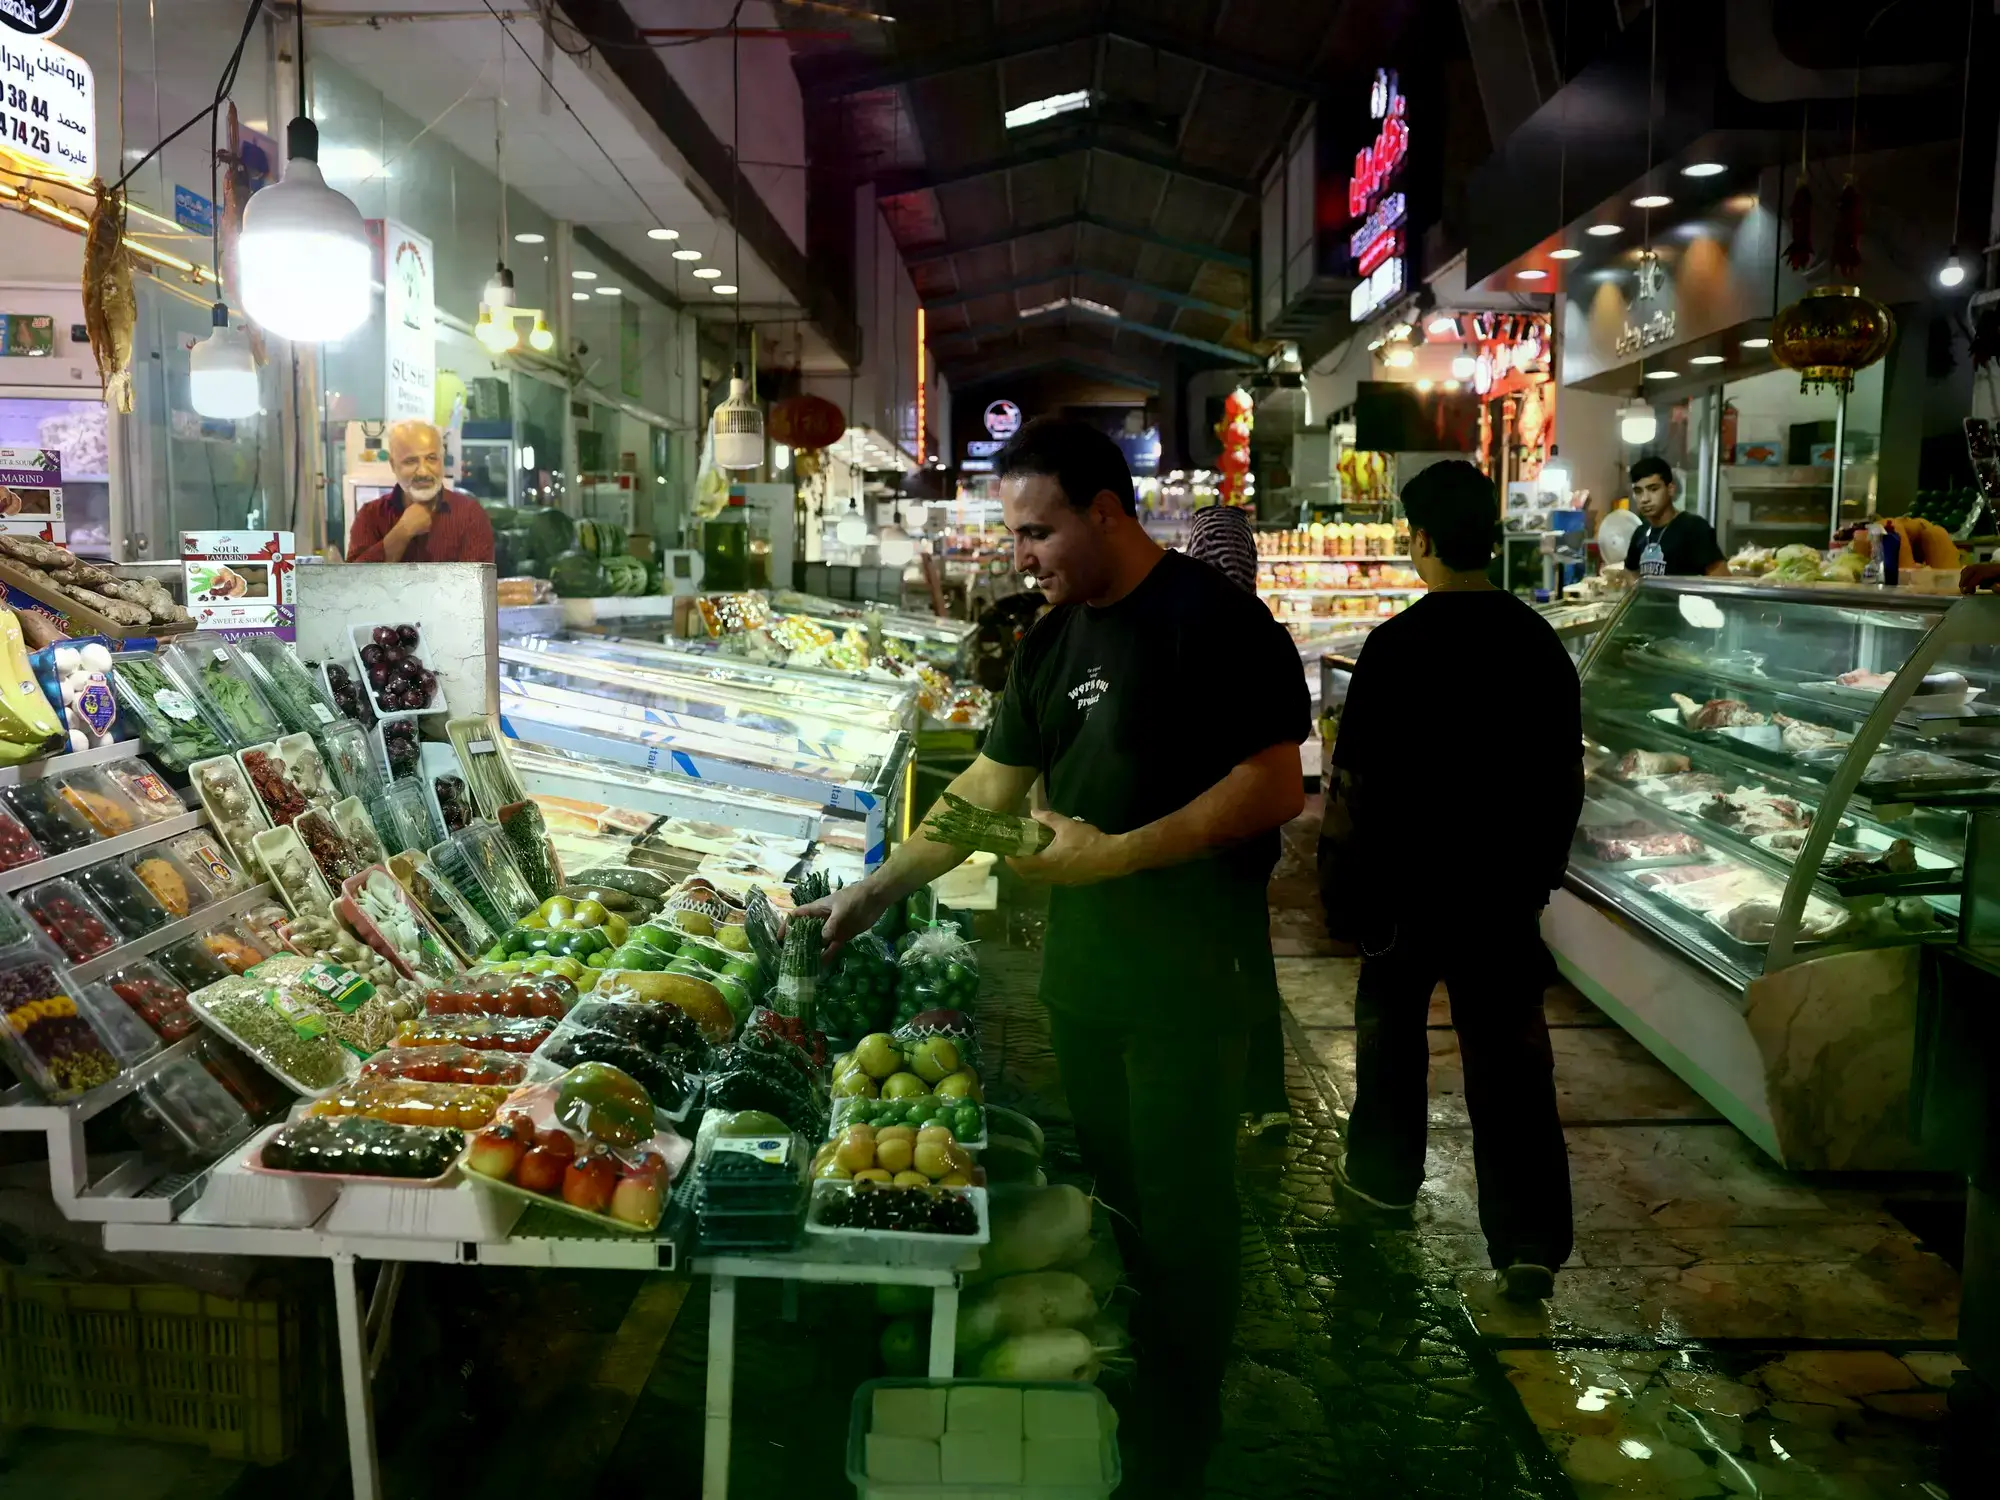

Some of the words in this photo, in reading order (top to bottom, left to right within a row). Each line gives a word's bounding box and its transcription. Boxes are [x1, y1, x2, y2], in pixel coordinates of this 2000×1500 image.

[0, 45, 34, 82] برادرا
[8, 84, 27, 112] 38
[31, 96, 49, 122] 44
[10, 116, 28, 145] 74
[57, 113, 87, 135] محمد
[31, 126, 50, 154] 25
[57, 141, 87, 164] علیرضا
[46, 450, 60, 463] NEW
[0, 473, 44, 484] MARIND
[204, 553, 249, 561] TAMARIND
[212, 545, 240, 553] SOUR
[212, 617, 237, 625] SWEET
[245, 616, 264, 624] SOUR
[279, 606, 294, 619] NEW
